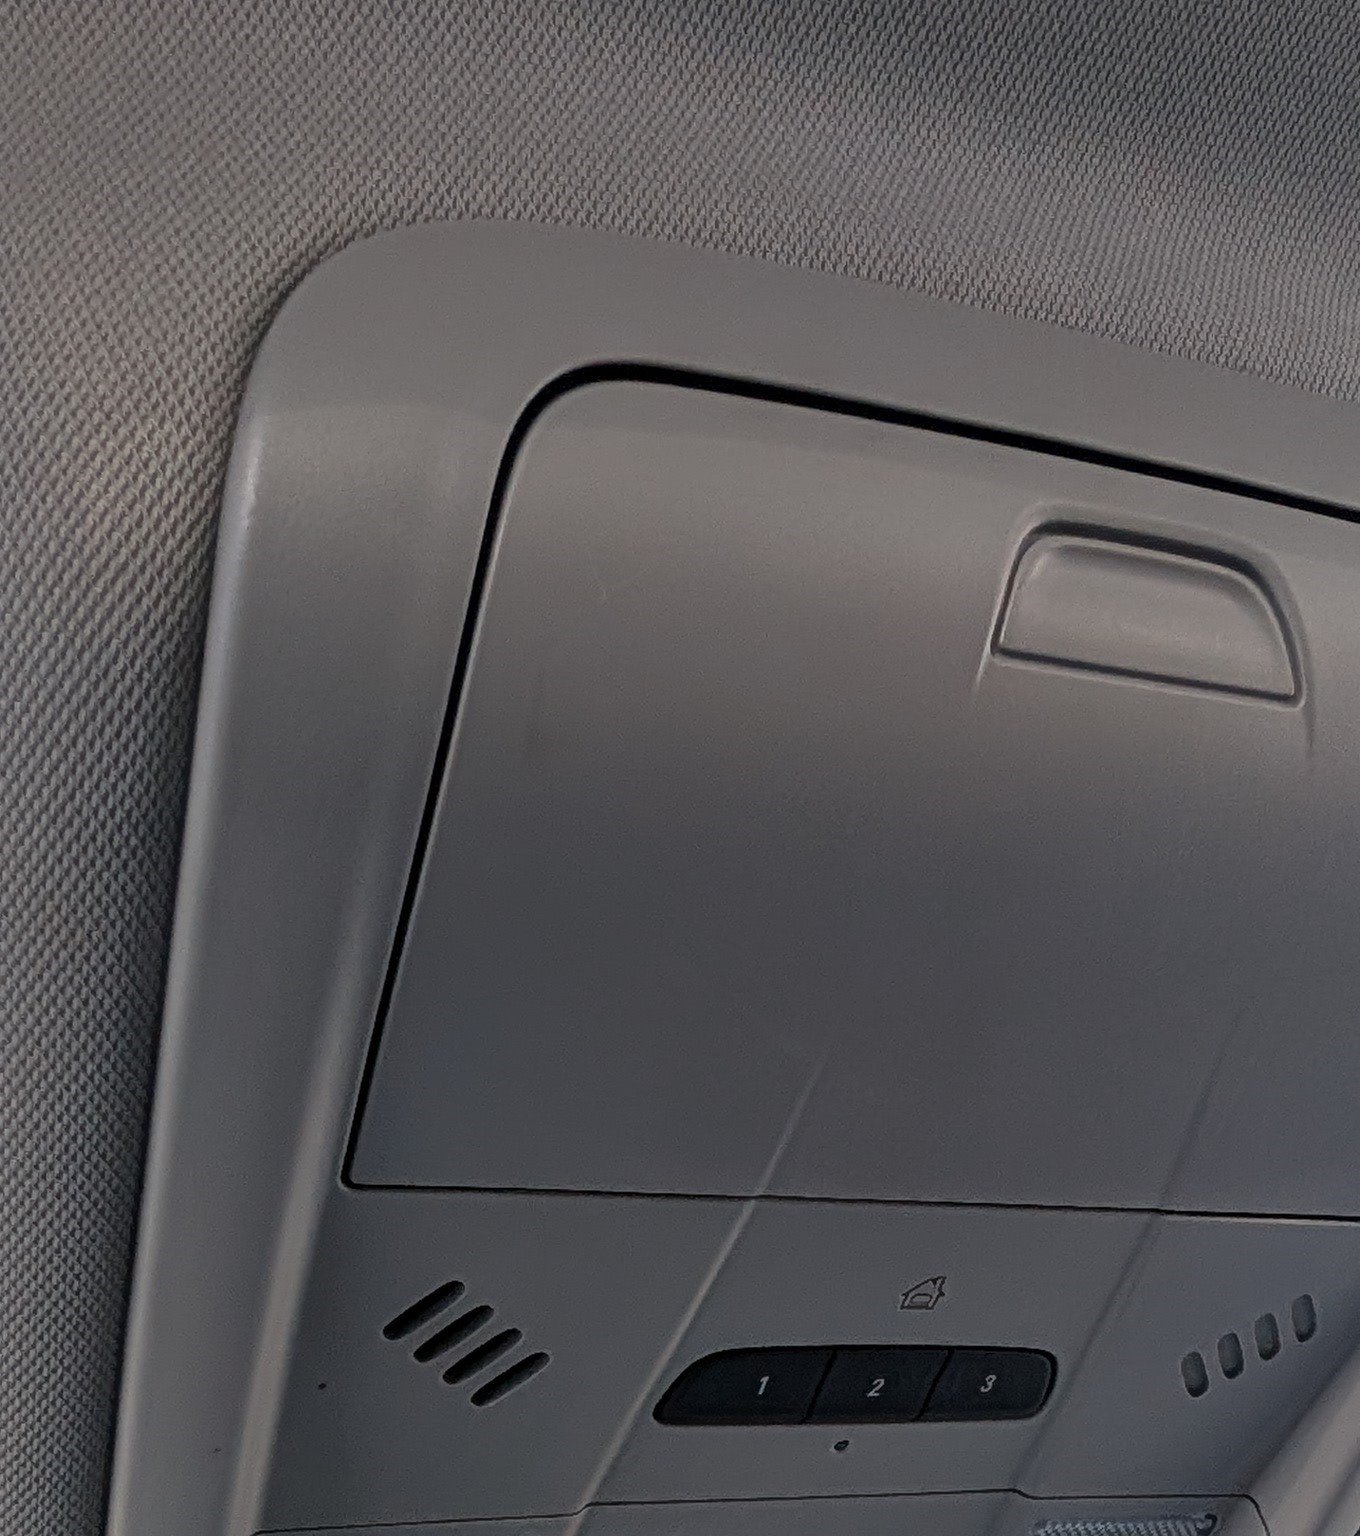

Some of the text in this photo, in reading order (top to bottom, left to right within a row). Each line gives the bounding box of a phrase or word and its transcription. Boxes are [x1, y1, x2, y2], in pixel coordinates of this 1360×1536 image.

[758, 1374, 997, 1398] 1 2 3
